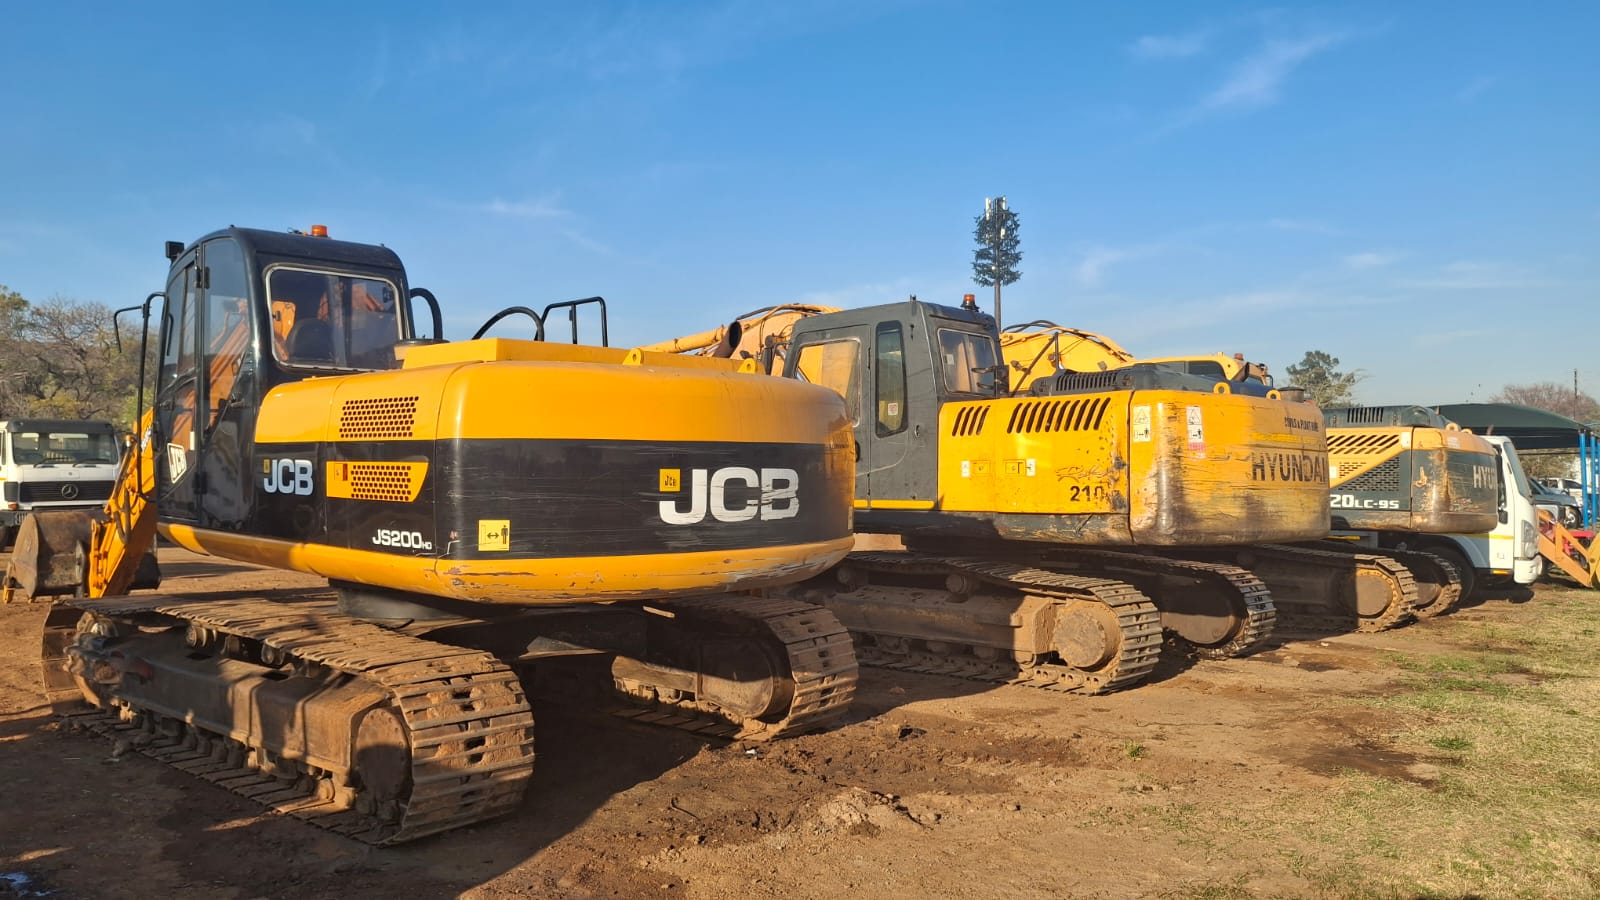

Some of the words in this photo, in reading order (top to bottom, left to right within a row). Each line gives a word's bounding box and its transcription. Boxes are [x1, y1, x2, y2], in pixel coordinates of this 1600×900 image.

[264, 458, 313, 495] JCB
[1251, 453, 1326, 482] HYUNDAI
[1473, 465, 1498, 490] HYU
[659, 467, 799, 525] JCB
